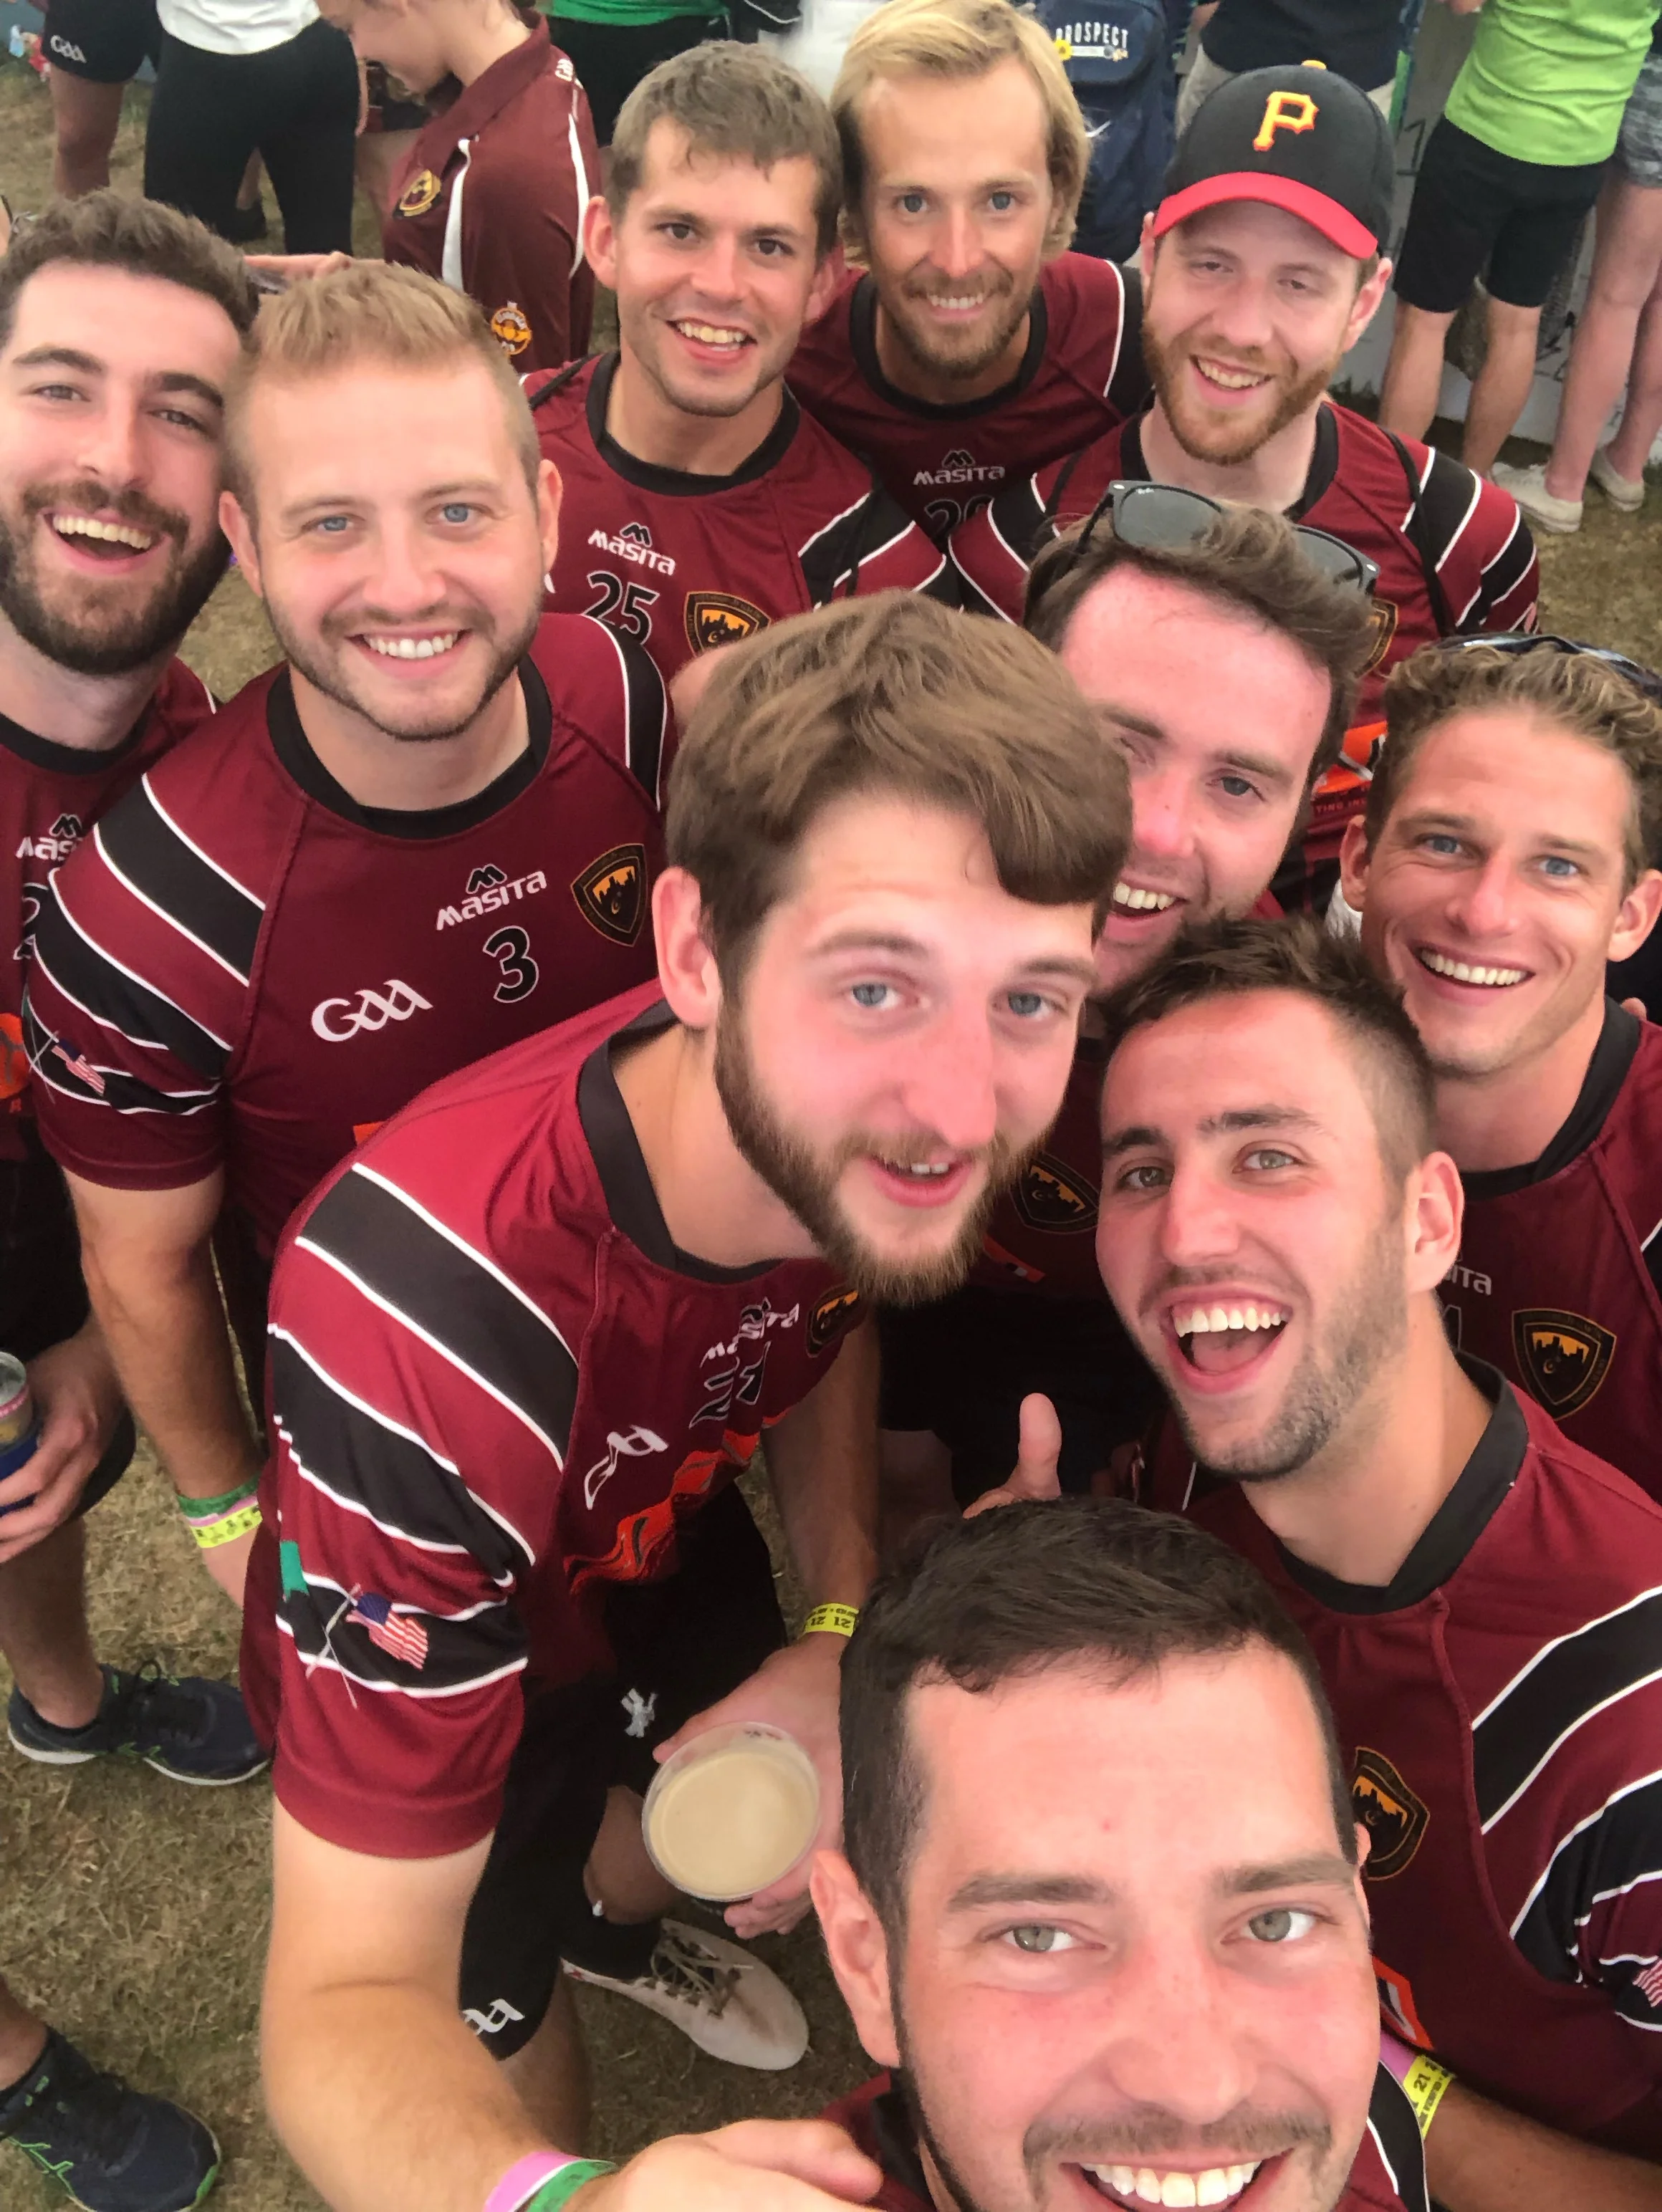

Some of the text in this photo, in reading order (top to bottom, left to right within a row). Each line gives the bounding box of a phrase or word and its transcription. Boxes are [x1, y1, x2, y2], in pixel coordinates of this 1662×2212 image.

[1252, 91, 1320, 152] P
[582, 570, 661, 645] 25
[482, 925, 539, 1004] 3
